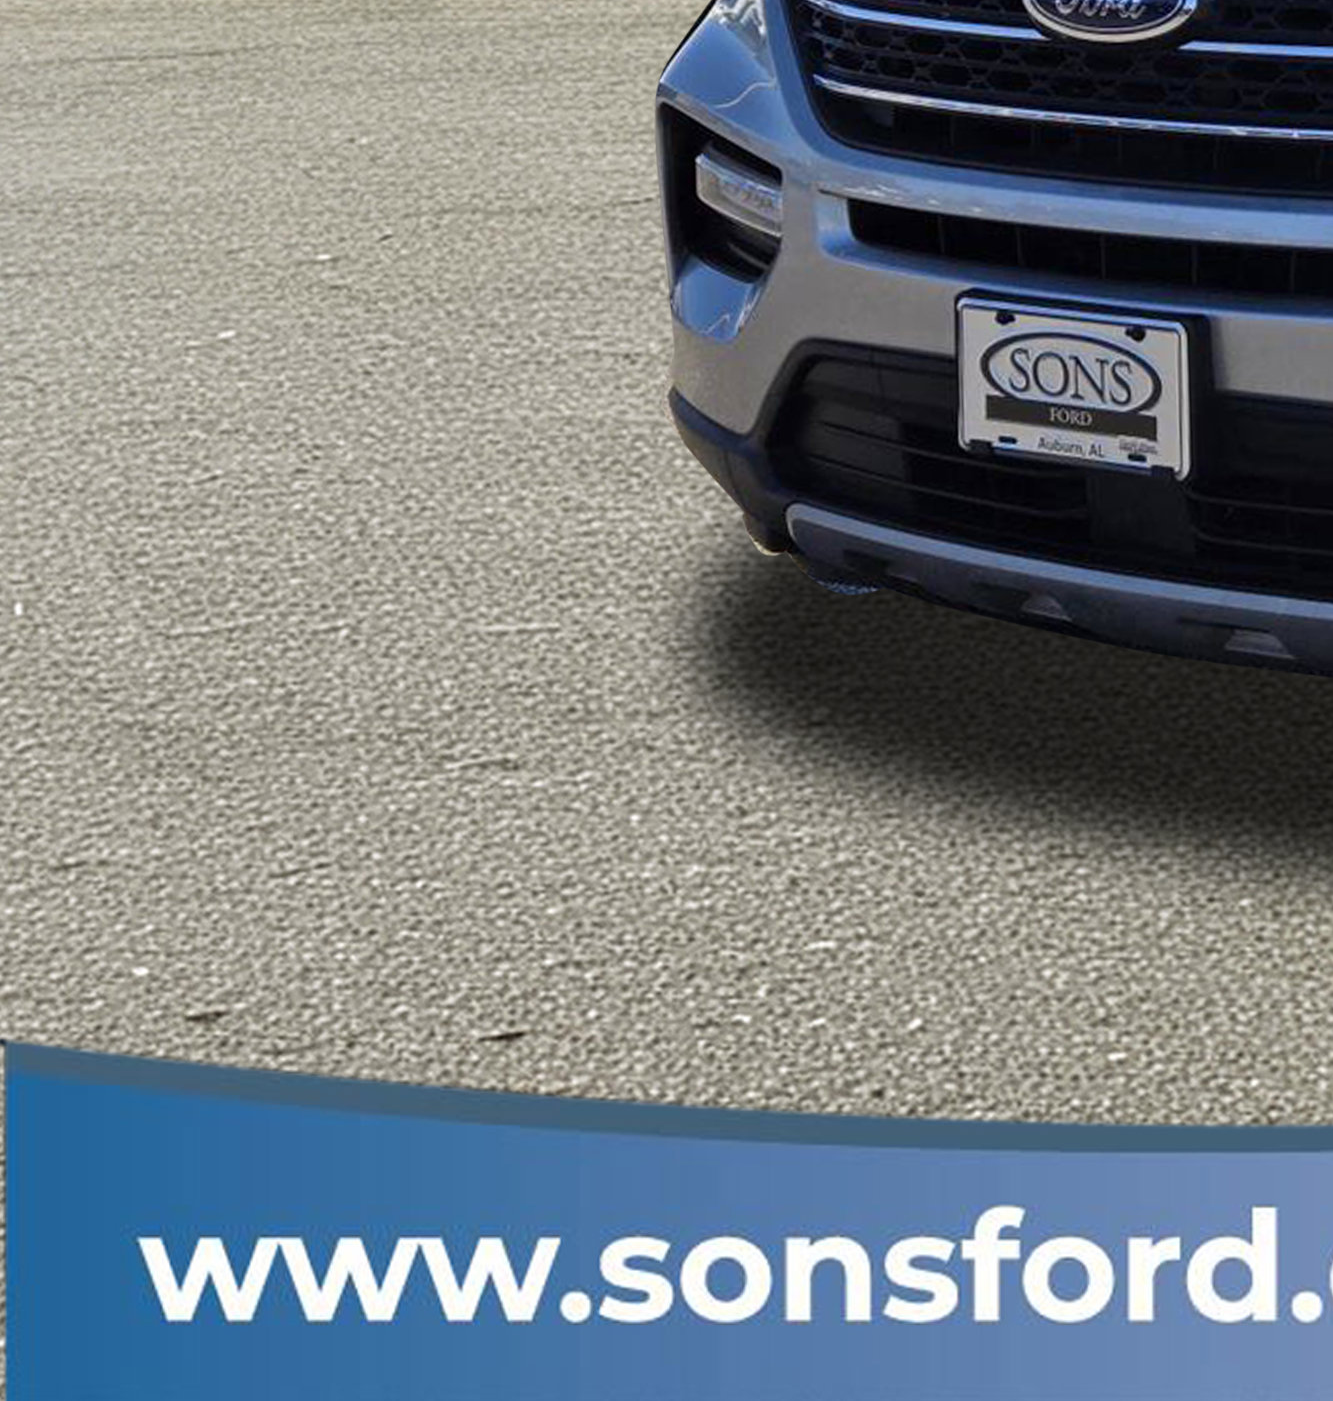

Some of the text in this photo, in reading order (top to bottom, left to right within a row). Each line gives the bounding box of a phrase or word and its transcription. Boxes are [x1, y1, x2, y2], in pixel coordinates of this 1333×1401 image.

[1008, 347, 1132, 405] SONS
[1049, 407, 1093, 426] FORD
[1037, 437, 1085, 457] Auburn,
[1087, 443, 1105, 458] AL
